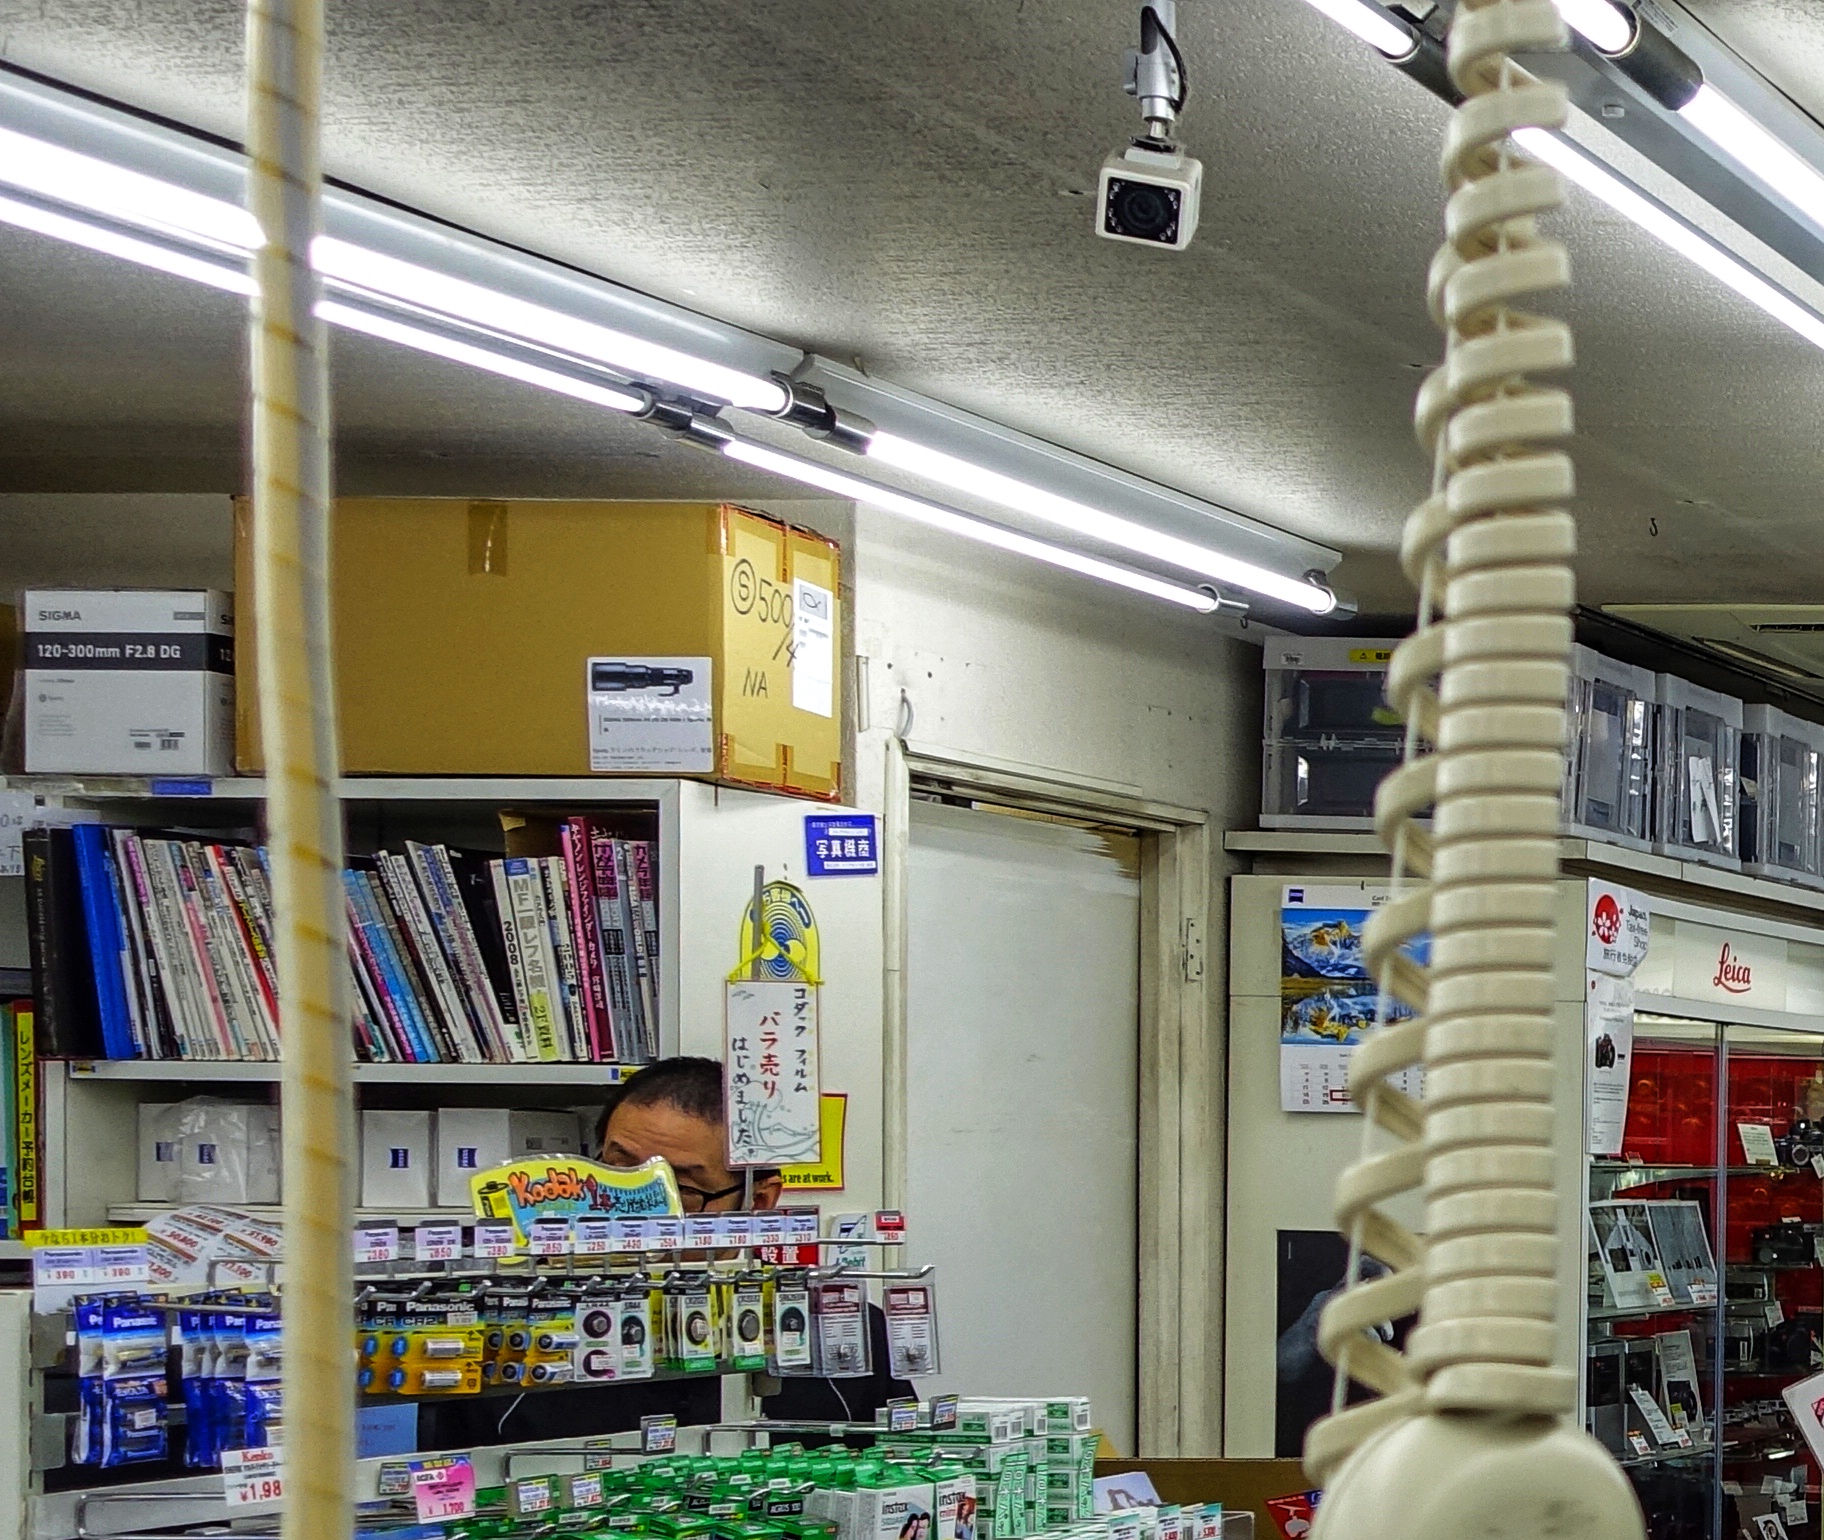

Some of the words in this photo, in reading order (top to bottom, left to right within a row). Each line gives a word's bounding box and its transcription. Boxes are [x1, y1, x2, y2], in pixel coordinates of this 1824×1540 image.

[39, 610, 81, 621] SIGMA
[37, 644, 120, 658] 120-300mm
[124, 644, 156, 658] F2.8
[159, 645, 181, 658] DG
[742, 667, 768, 698] NA
[1712, 941, 1752, 994] Leica
[759, 1010, 781, 1100] バラ売り
[508, 1166, 586, 1209] Kodak
[406, 1301, 475, 1313] Panasonic
[241, 1449, 274, 1462] Kenko
